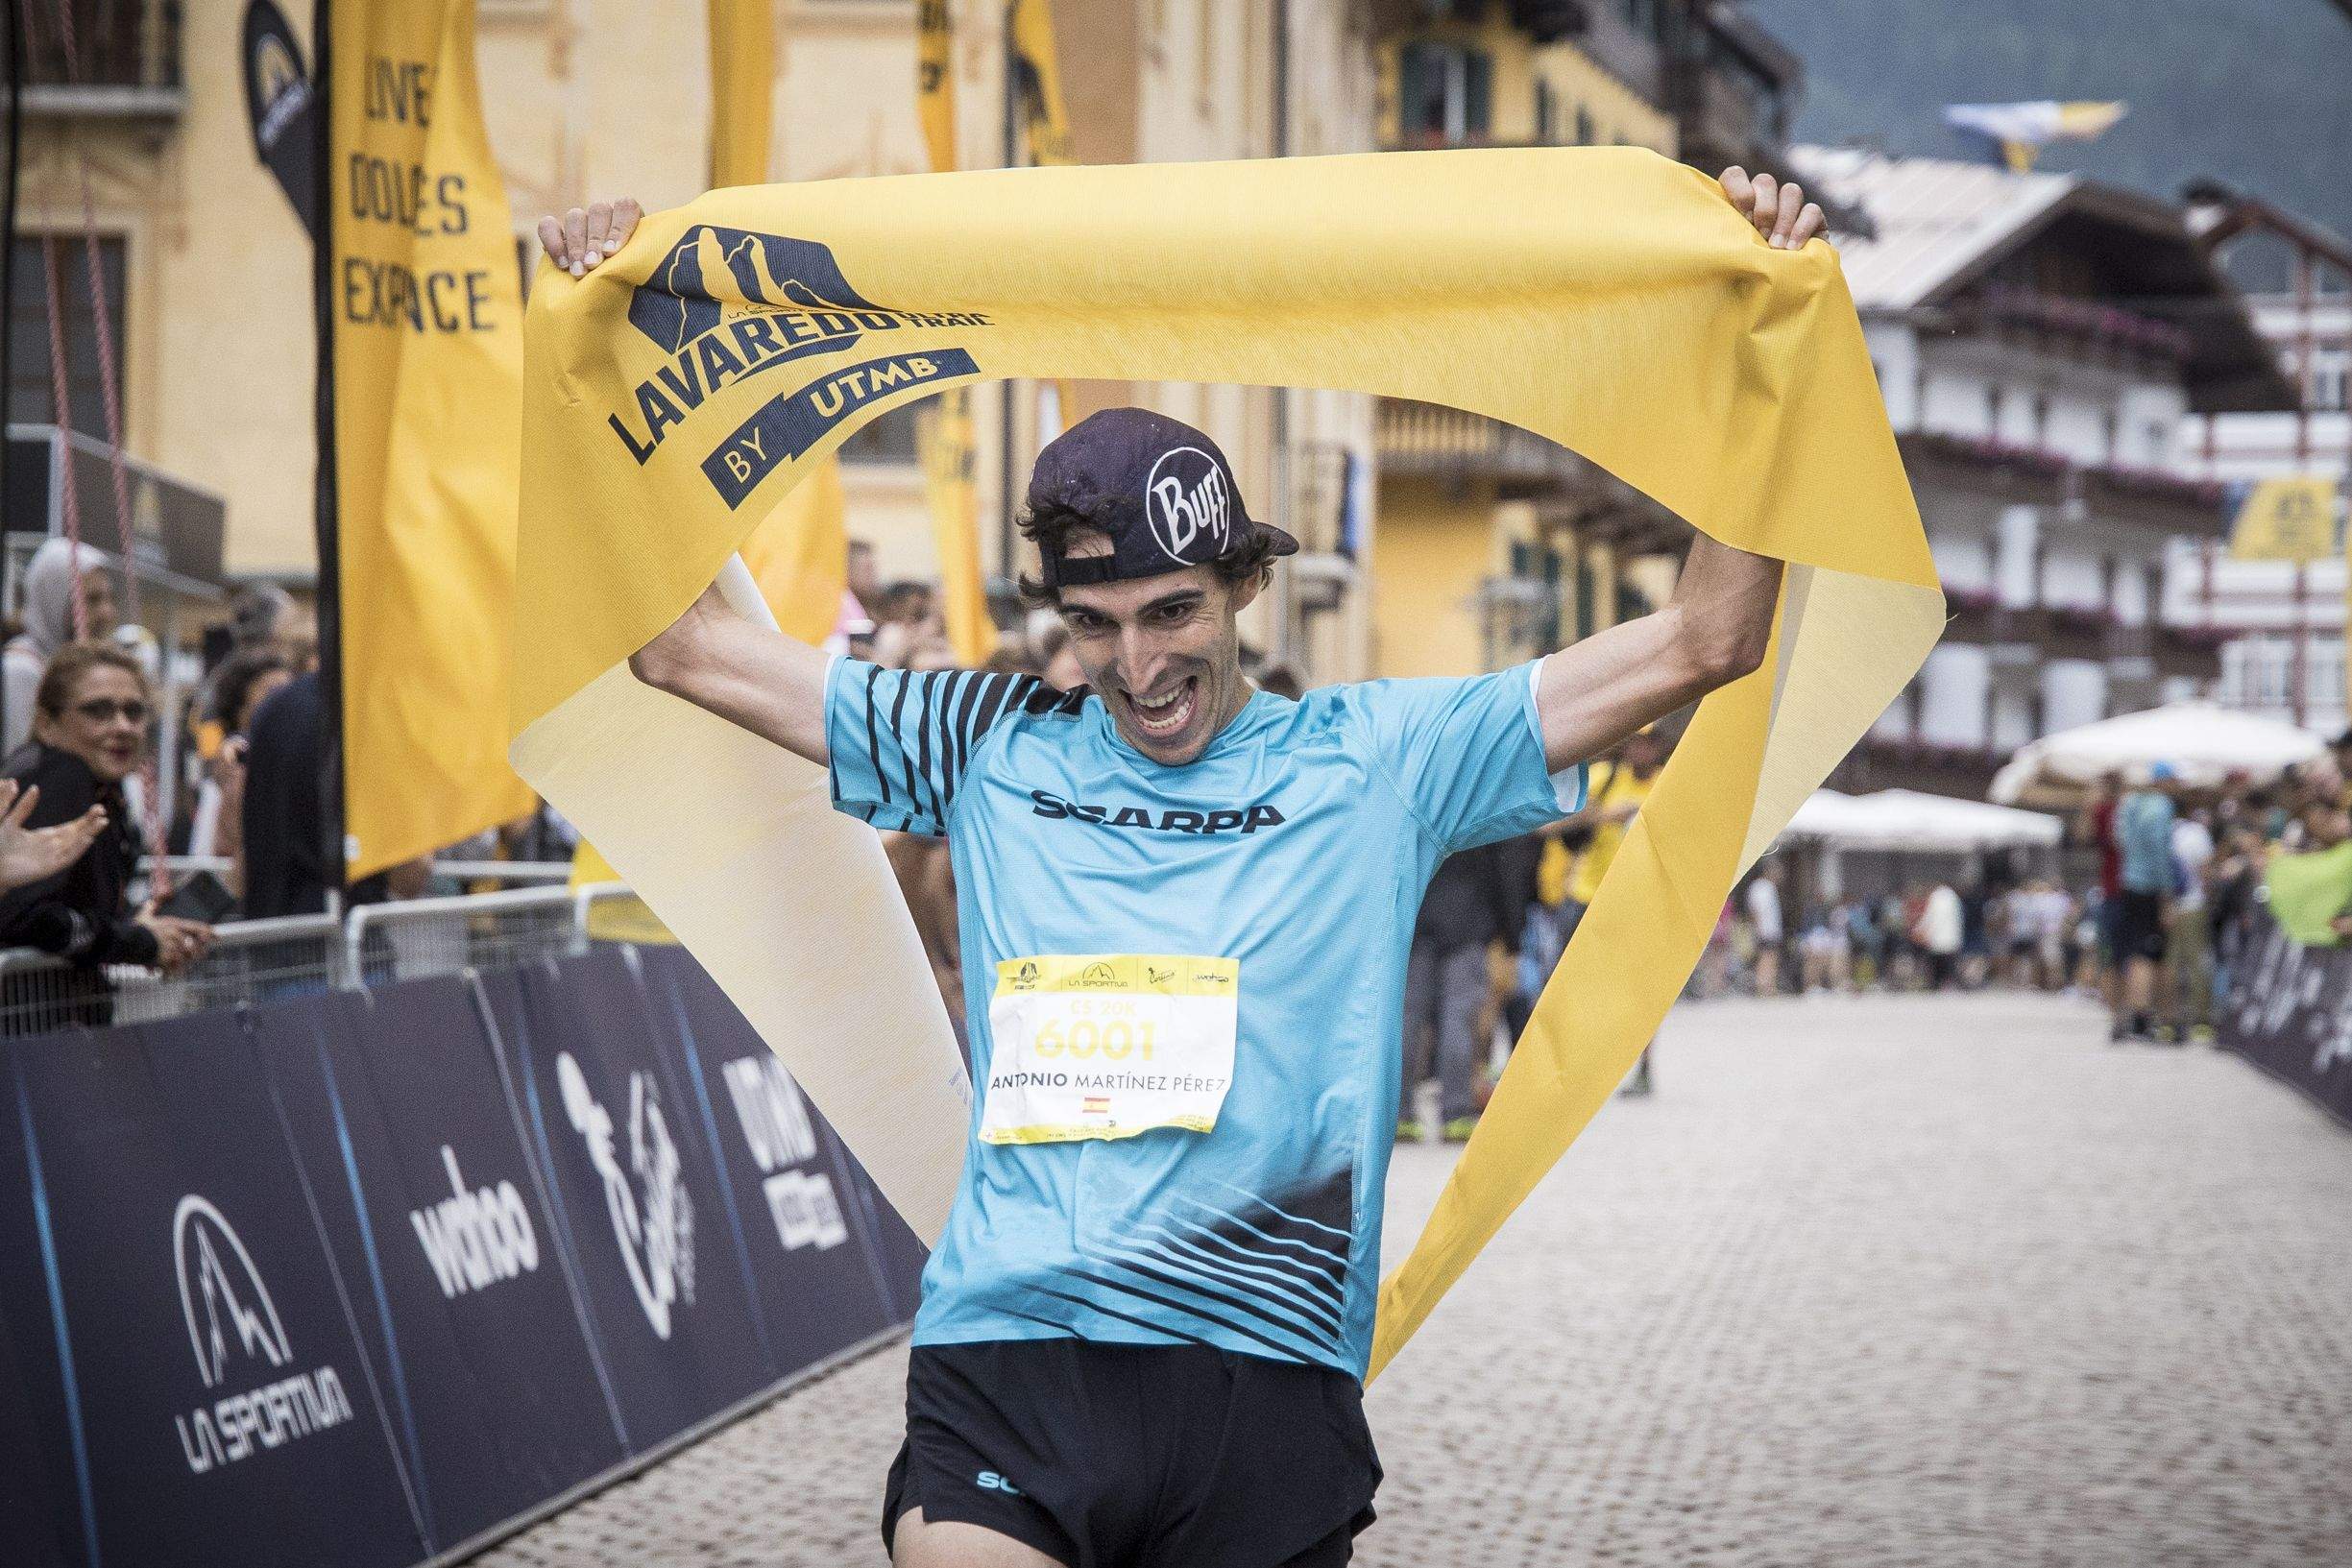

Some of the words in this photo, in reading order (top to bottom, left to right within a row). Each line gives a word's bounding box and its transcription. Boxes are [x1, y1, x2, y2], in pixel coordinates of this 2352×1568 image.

[904, 316, 996, 328] TRAIL
[607, 309, 901, 467] LAVAREDO
[723, 427, 775, 484] BY
[810, 356, 939, 419] UTMB
[1151, 465, 1226, 556] Buff
[1030, 788, 1287, 834] SCARPA
[1082, 979, 1128, 988] SPORTIVA
[1034, 1018, 1158, 1060] 6001
[991, 1073, 1068, 1090] ANTONIO
[1075, 1071, 1167, 1091] MARTÍNEZ
[1174, 1073, 1226, 1093] PÉREZ
[175, 1407, 228, 1475] LA
[213, 1364, 354, 1462] SPORTIVA
